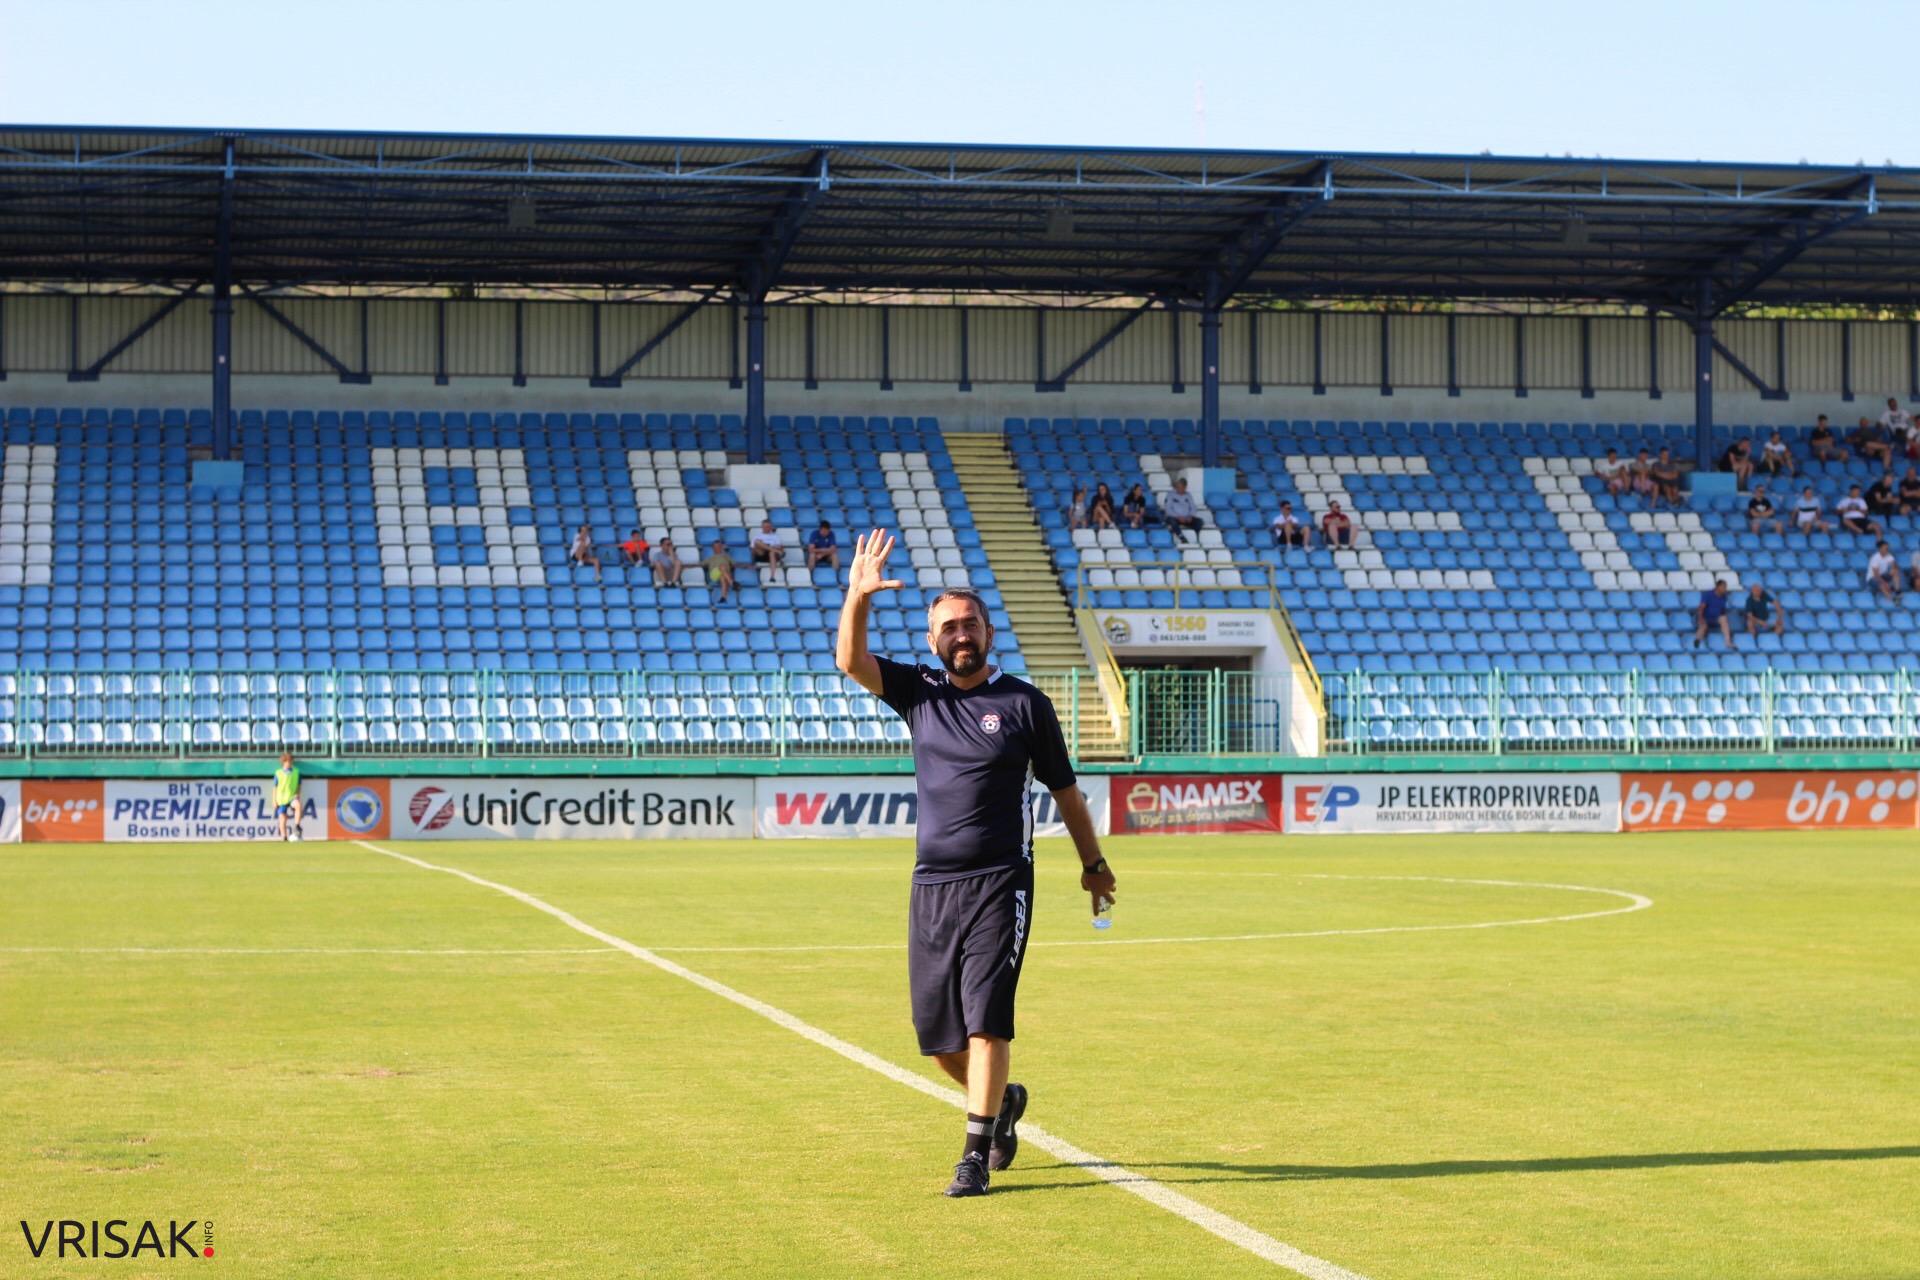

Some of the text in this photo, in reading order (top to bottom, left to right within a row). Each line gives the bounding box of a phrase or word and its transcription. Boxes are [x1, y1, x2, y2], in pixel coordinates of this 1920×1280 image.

[1164, 616, 1207, 632] 1560
[168, 783, 262, 796] BH Telecom
[1159, 780, 1265, 811] NAMEX
[1378, 785, 1600, 808] JP ELEKTROPRIVREDA
[113, 798, 318, 820] PREMIJER LA
[463, 788, 735, 826] UniCredit Bank
[1376, 810, 1423, 822] HRVATSKE
[1426, 810, 1475, 822] ZAJEDNICE
[1478, 810, 1514, 821] HERCEG
[1516, 810, 1547, 821] BOSNE
[128, 824, 181, 838] Bosne
[1009, 890, 1027, 969] LEGEA
